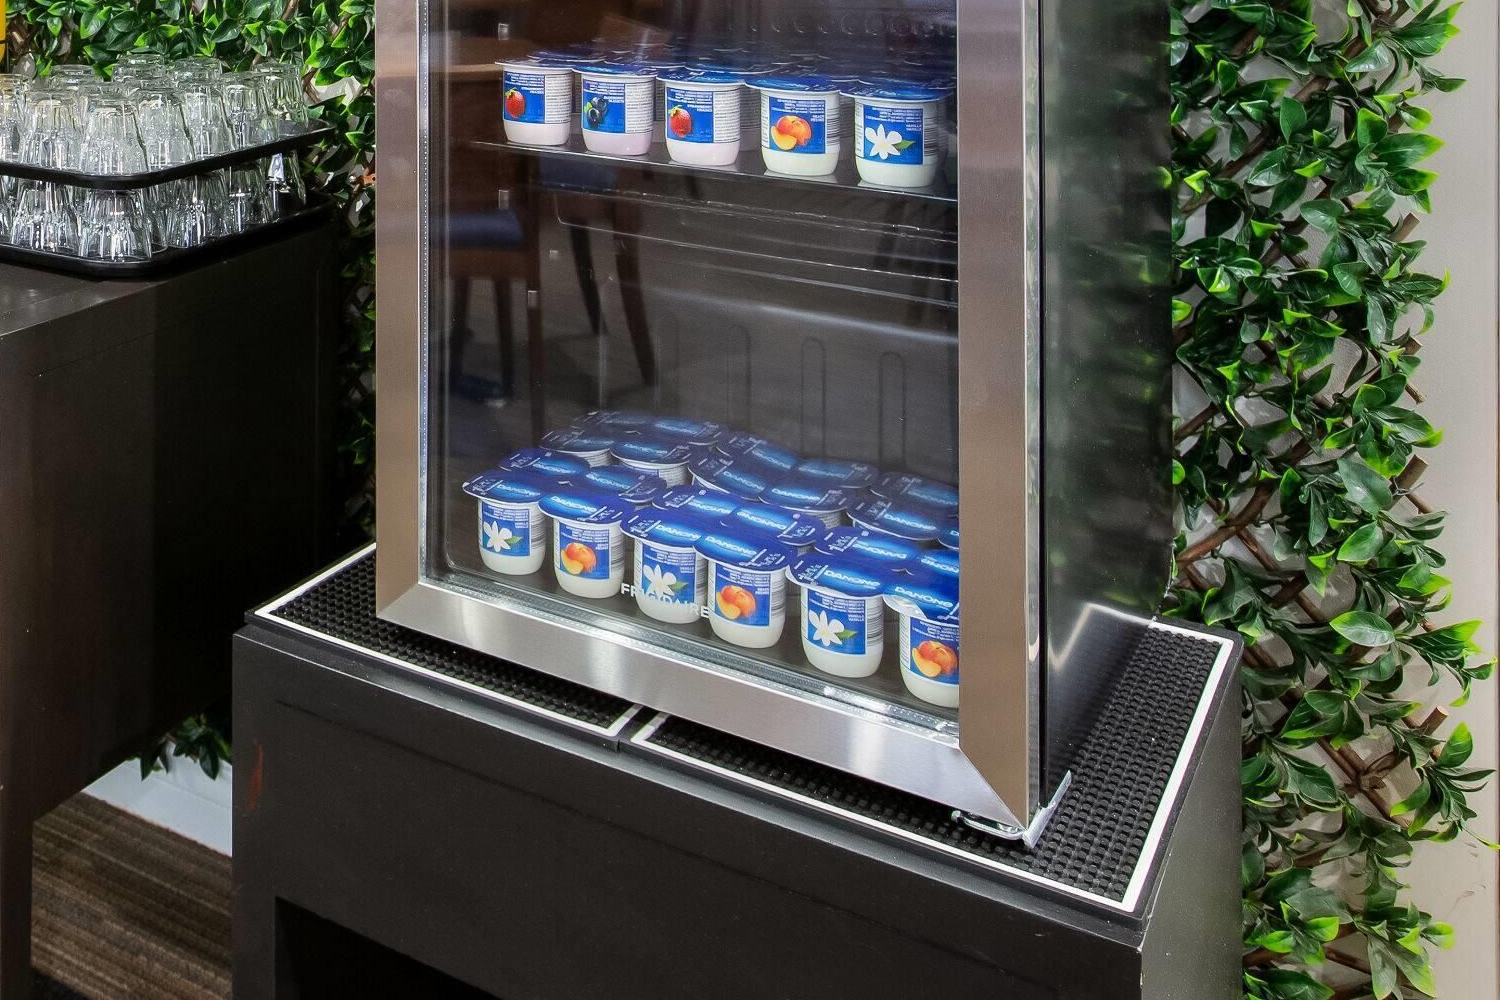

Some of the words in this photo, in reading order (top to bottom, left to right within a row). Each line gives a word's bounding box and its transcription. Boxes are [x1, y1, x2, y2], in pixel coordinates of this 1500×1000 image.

[550, 495, 598, 513] DANONE
[884, 513, 937, 531] DANONE
[705, 535, 757, 555] DANONE
[853, 543, 908, 560] DANONE
[823, 569, 881, 588] DANONE
[620, 583, 709, 618] FRGDAIRE
[894, 586, 954, 608] DANONE
